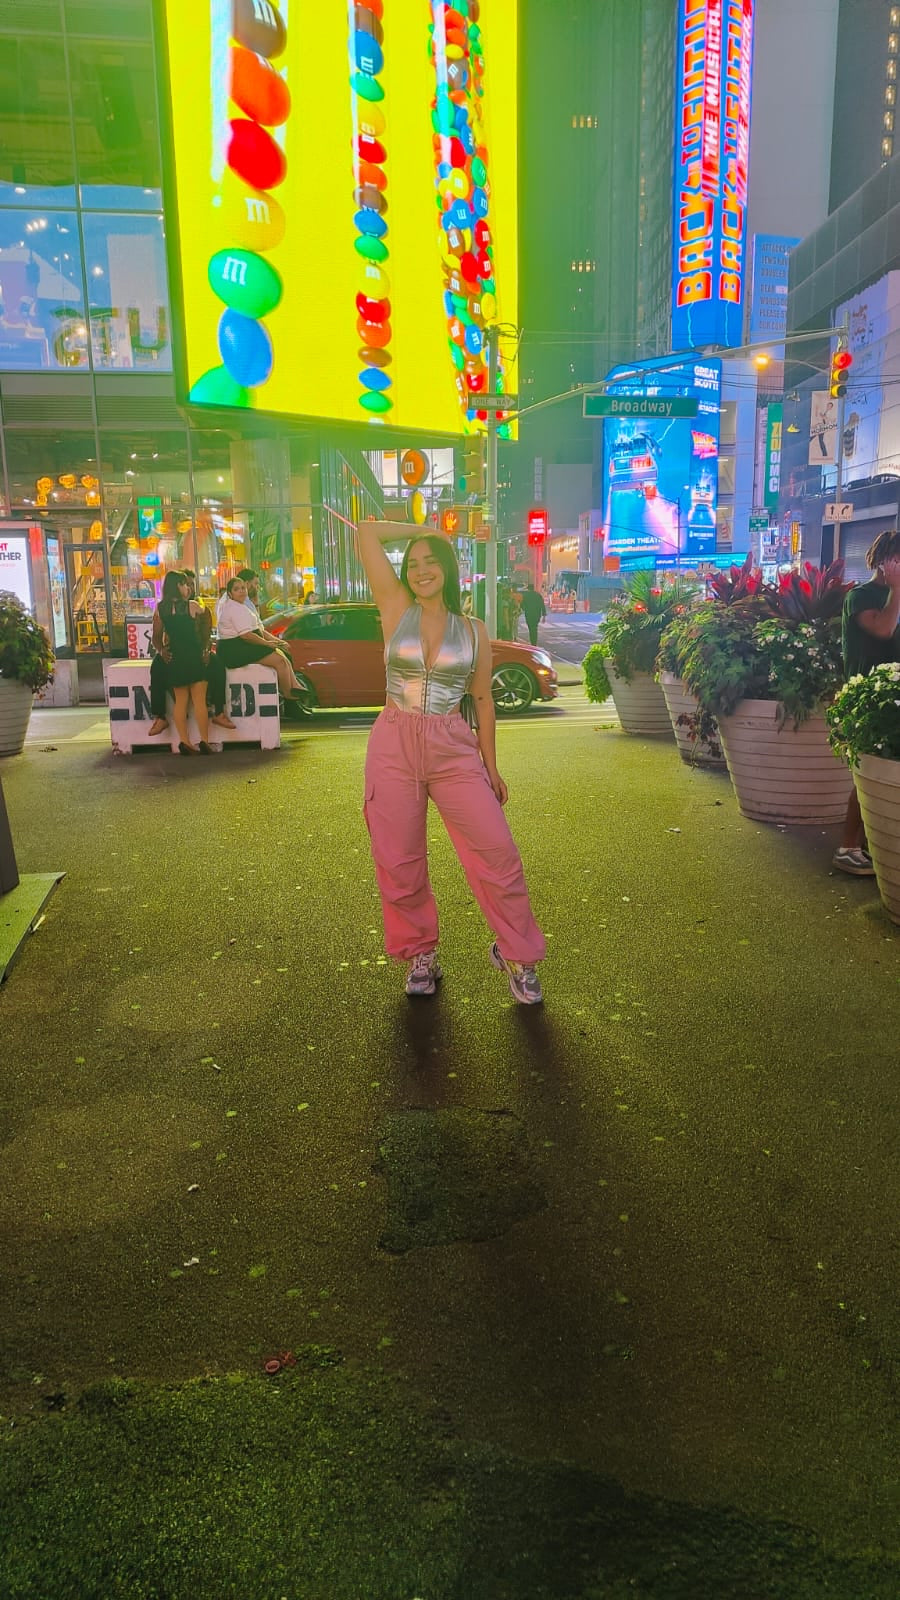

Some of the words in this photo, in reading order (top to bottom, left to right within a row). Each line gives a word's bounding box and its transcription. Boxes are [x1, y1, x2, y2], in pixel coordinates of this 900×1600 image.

[726, 0, 743, 120] FUTU
[681, 125, 701, 166] TO
[703, 110, 718, 159] THE
[724, 121, 737, 156] TO
[244, 197, 271, 224] m
[677, 191, 714, 307] BACK
[719, 182, 743, 304] BACK
[222, 256, 247, 286] m
[694, 366, 719, 380] GREAT
[694, 378, 719, 391] SCOTT!
[611, 399, 673, 416] Broadway
[811, 424, 837, 434] MORMON
[404, 461, 415, 473] m
